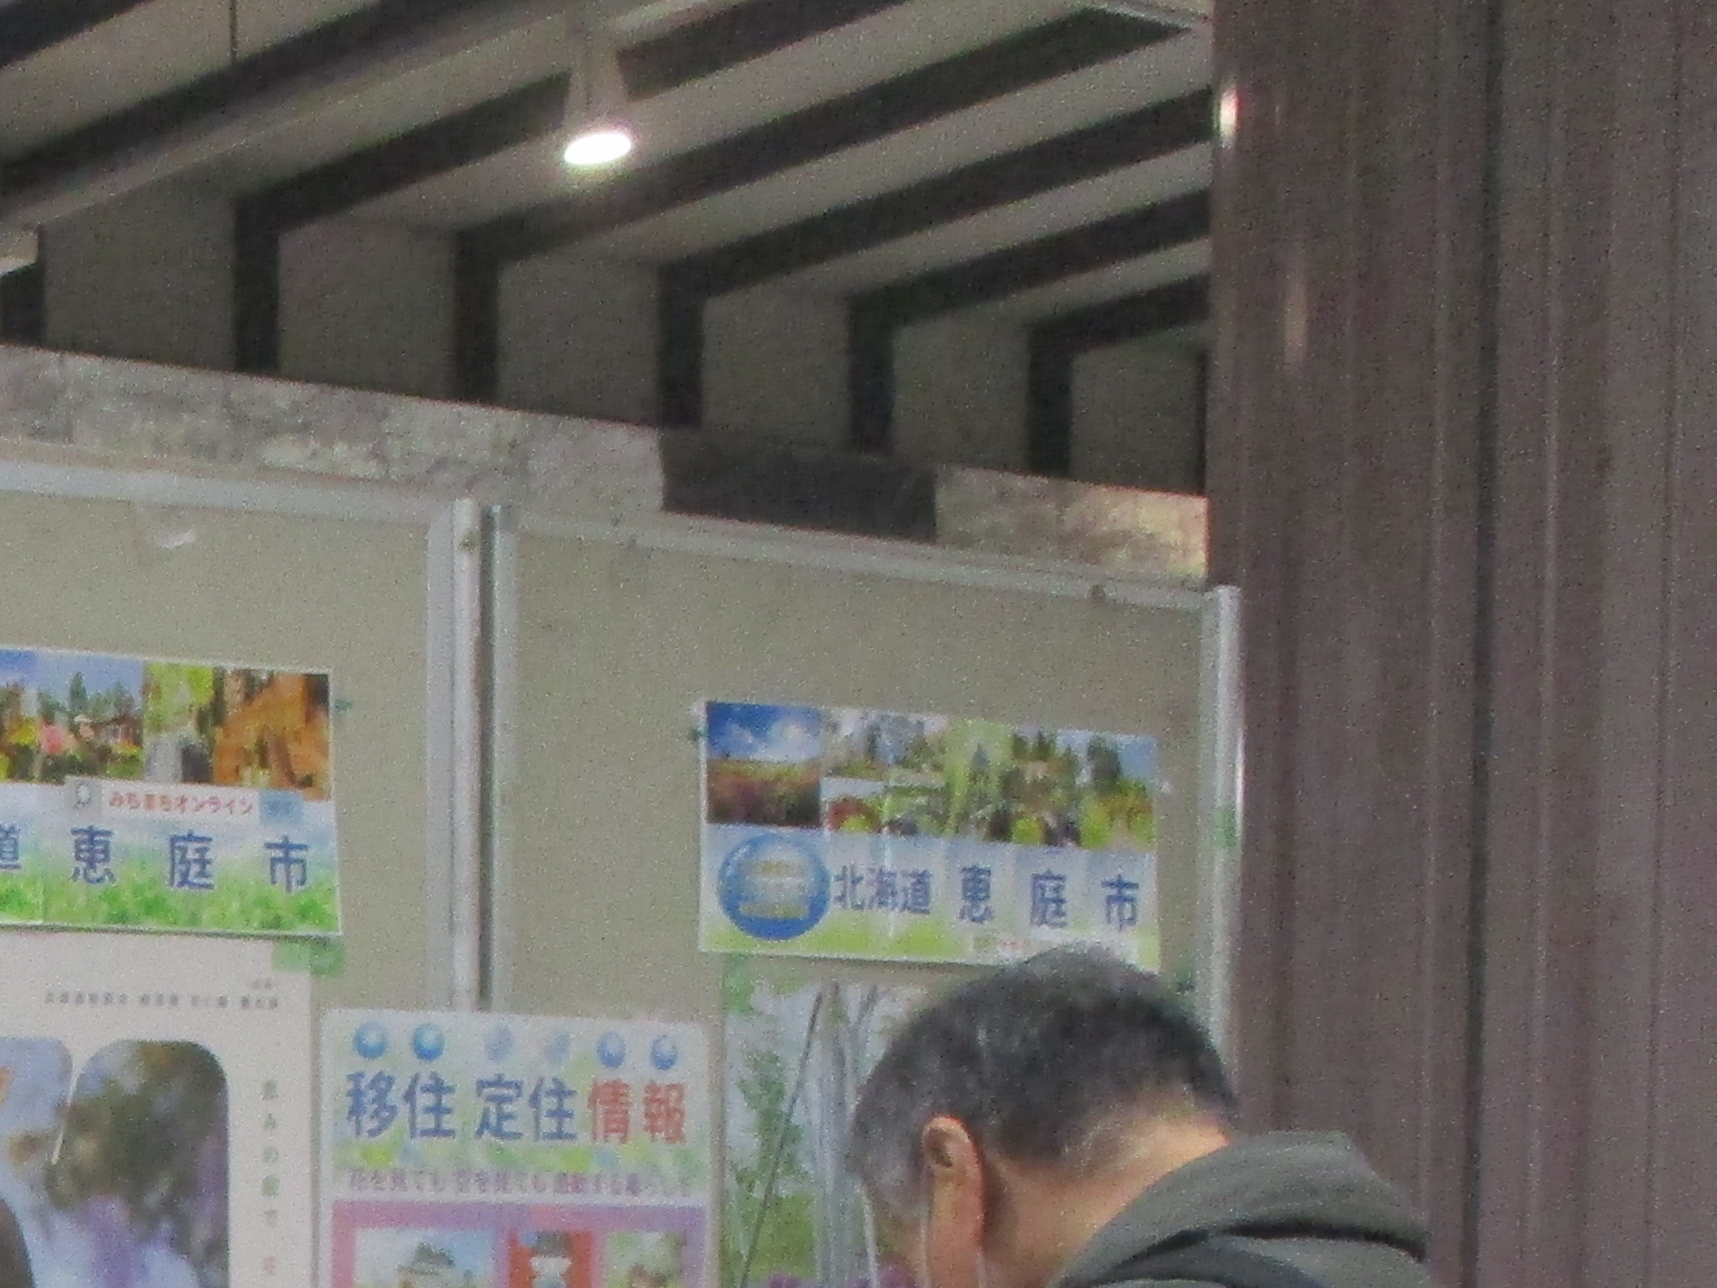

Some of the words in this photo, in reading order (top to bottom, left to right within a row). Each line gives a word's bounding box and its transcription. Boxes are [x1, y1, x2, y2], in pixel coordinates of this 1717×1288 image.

[69, 825, 309, 893] 恵庭市
[834, 863, 932, 915] 北海道
[958, 864, 1140, 933] 恵庭市
